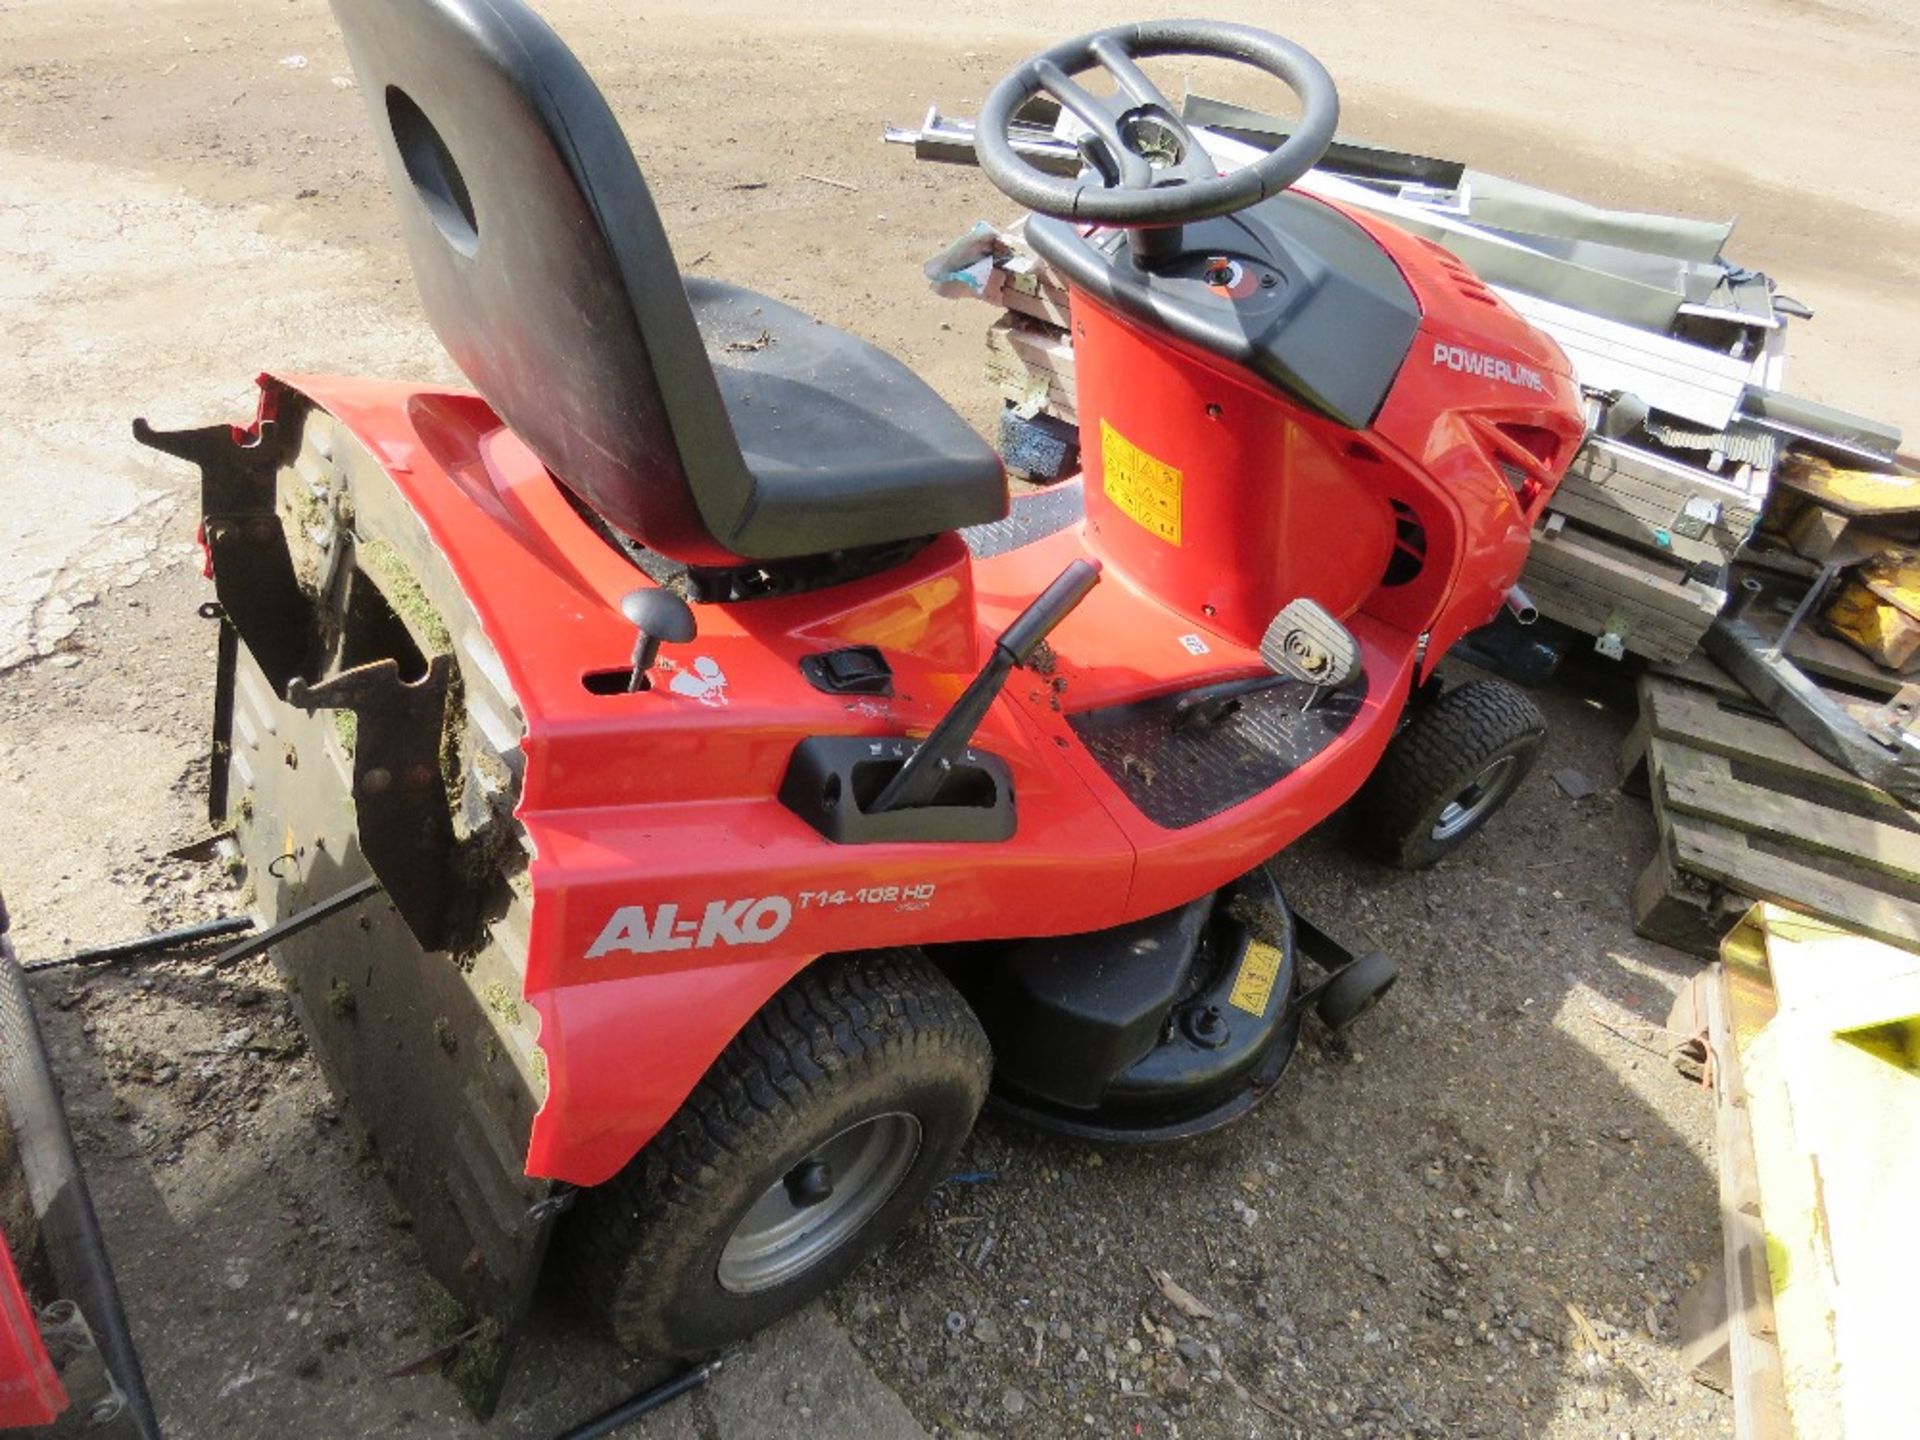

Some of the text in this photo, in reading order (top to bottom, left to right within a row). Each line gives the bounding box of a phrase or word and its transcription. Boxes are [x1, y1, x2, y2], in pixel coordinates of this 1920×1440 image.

[1433, 343, 1543, 393] POWERLINE
[798, 886, 899, 909] T14-102
[902, 884, 936, 901] HD
[584, 896, 792, 959] AL-KO
